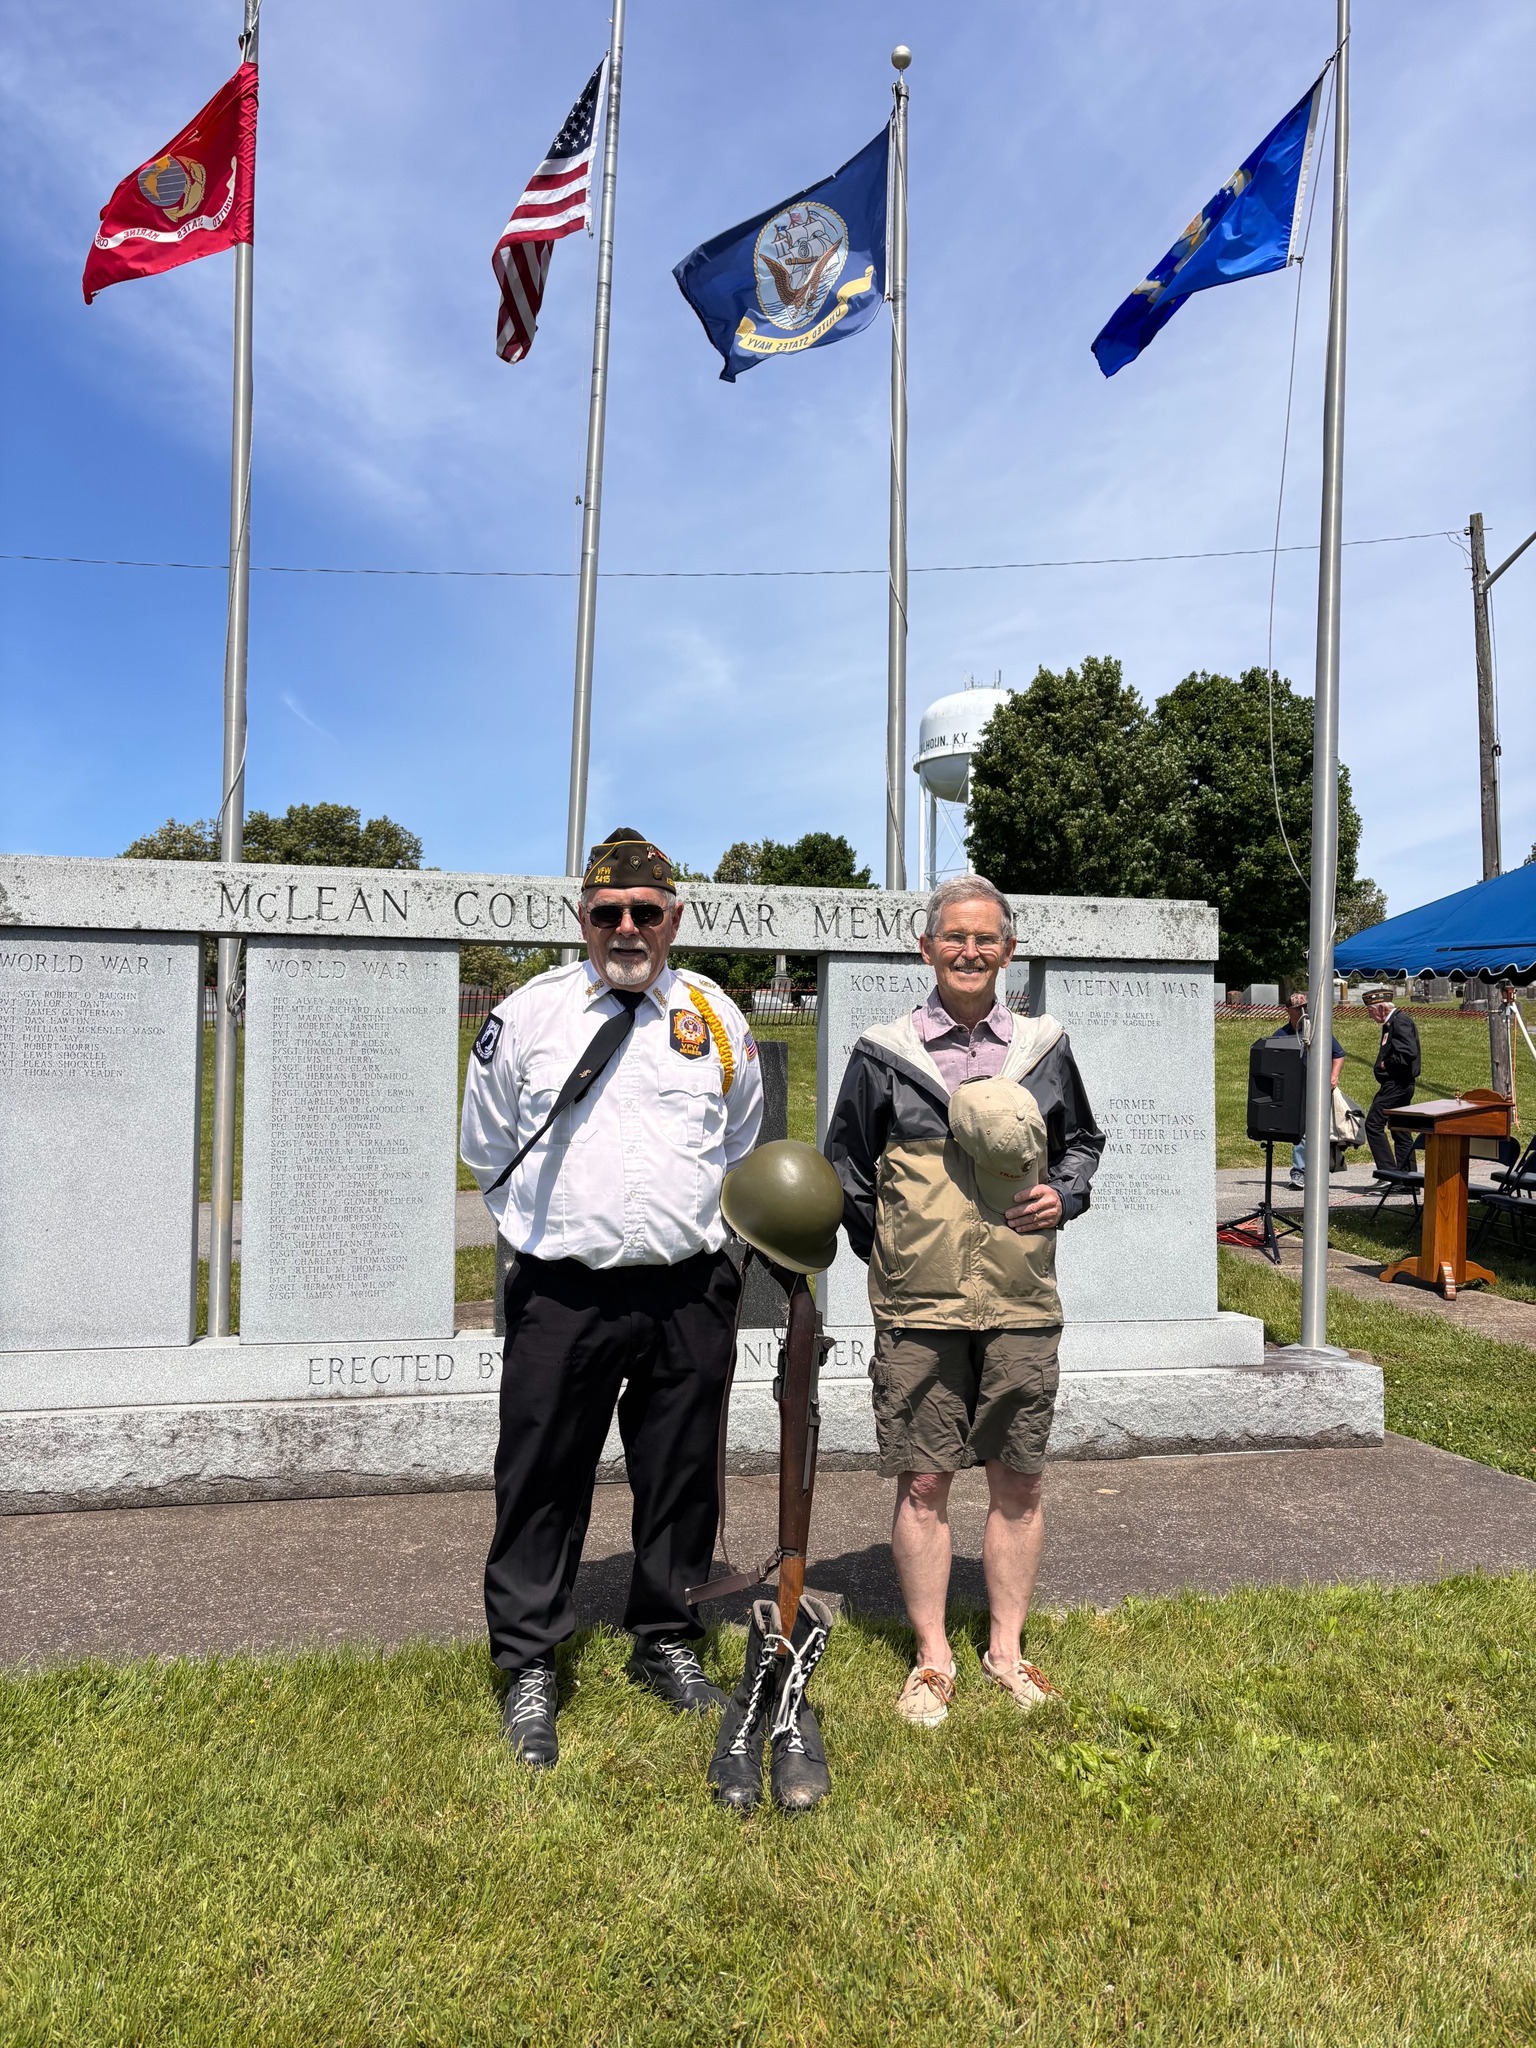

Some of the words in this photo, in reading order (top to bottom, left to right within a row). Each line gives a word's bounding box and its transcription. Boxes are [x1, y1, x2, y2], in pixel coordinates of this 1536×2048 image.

[953, 732, 967, 744] KY
[597, 866, 612, 876] VFW
[594, 875, 611, 884] 5415
[454, 890, 584, 931] COUN
[690, 900, 778, 938] WAR
[0, 952, 84, 974] WORLD
[100, 955, 151, 977] WAR
[166, 957, 173, 977] I
[266, 958, 347, 980] WORLD
[362, 961, 410, 981] WAR
[424, 962, 440, 981] II
[850, 974, 931, 994] KOREAN
[1062, 979, 1150, 998] VIETNAM
[1161, 981, 1201, 999] WAR
[43, 990, 79, 999] ROBERT
[25, 1008, 58, 1016] JAMES
[329, 1006, 370, 1014] RICHARD
[374, 1006, 429, 1015] ALEXANDER
[24, 1016, 46, 1025] DAN
[298, 1014, 334, 1022] MARVIN
[351, 1014, 385, 1023] AUSTIN
[25, 1025, 68, 1034] WILLIAM
[133, 1027, 166, 1035] MASON
[298, 1022, 331, 1031] ROBERT
[321, 1031, 374, 1039] BLACKWELL
[24, 1042, 60, 1051] ROBERT
[64, 1043, 100, 1052] MORRIS
[295, 1039, 334, 1047] THOMAS
[306, 1047, 344, 1055] HAROLD
[361, 1047, 401, 1056] BOWMAN
[338, 1055, 374, 1064] CHERRY
[306, 1064, 333, 1072] HUGH
[350, 1063, 381, 1072] CLARK
[23, 1068, 64, 1077] THOMAS
[306, 1072, 347, 1081] HERMAN
[297, 1080, 324, 1089] HUGH
[341, 1080, 374, 1089] DURBIN
[306, 1089, 342, 1097] LAYTON
[347, 1088, 382, 1097] DUDLEY
[387, 1088, 415, 1097] ERWIN
[294, 1097, 335, 1106] CHARLIE
[1108, 1098, 1156, 1111] FORMER
[307, 1105, 348, 1114] WILLIAM
[296, 1114, 320, 1122] FRED
[338, 1113, 380, 1122] GOODWIN
[1125, 1113, 1195, 1126] COUNTIANS
[294, 1122, 325, 1131] DEWEY
[344, 1122, 382, 1130] HOWARD
[294, 1131, 325, 1139] JAMES
[343, 1130, 371, 1139] JONES
[1130, 1128, 1166, 1141] THEIR
[1173, 1129, 1207, 1142] LIVES
[306, 1139, 340, 1147] WALTER
[358, 1139, 405, 1147] KIRKLAND
[1107, 1142, 1133, 1155] WAR
[1139, 1143, 1179, 1156] ZONES
[295, 1155, 344, 1164] LAWRENCE
[296, 1164, 336, 1173] WILLIAM
[382, 1171, 412, 1180] OWENS
[295, 1181, 335, 1190] PRESTON
[343, 1197, 380, 1206] GLOVER
[302, 1206, 337, 1215] GRUNDY
[344, 1205, 385, 1214] RICKARD
[294, 1215, 328, 1223] OLIVER
[331, 1214, 382, 1223] ROBERTSON
[293, 1223, 333, 1232] WILLIAM
[350, 1222, 400, 1231] ROBERTSON
[339, 1239, 374, 1248] TANNER
[303, 1249, 346, 1257] WILLARD
[294, 1257, 338, 1266] CHARLES
[353, 1255, 409, 1265] THOMASSON
[351, 1264, 405, 1273] THOMASSON
[326, 1273, 369, 1282] WHEELER
[302, 1282, 342, 1291] HERMAN
[361, 1280, 396, 1290] WILSON
[307, 1353, 456, 1386] ERECTED
[477, 1351, 504, 1380] B
